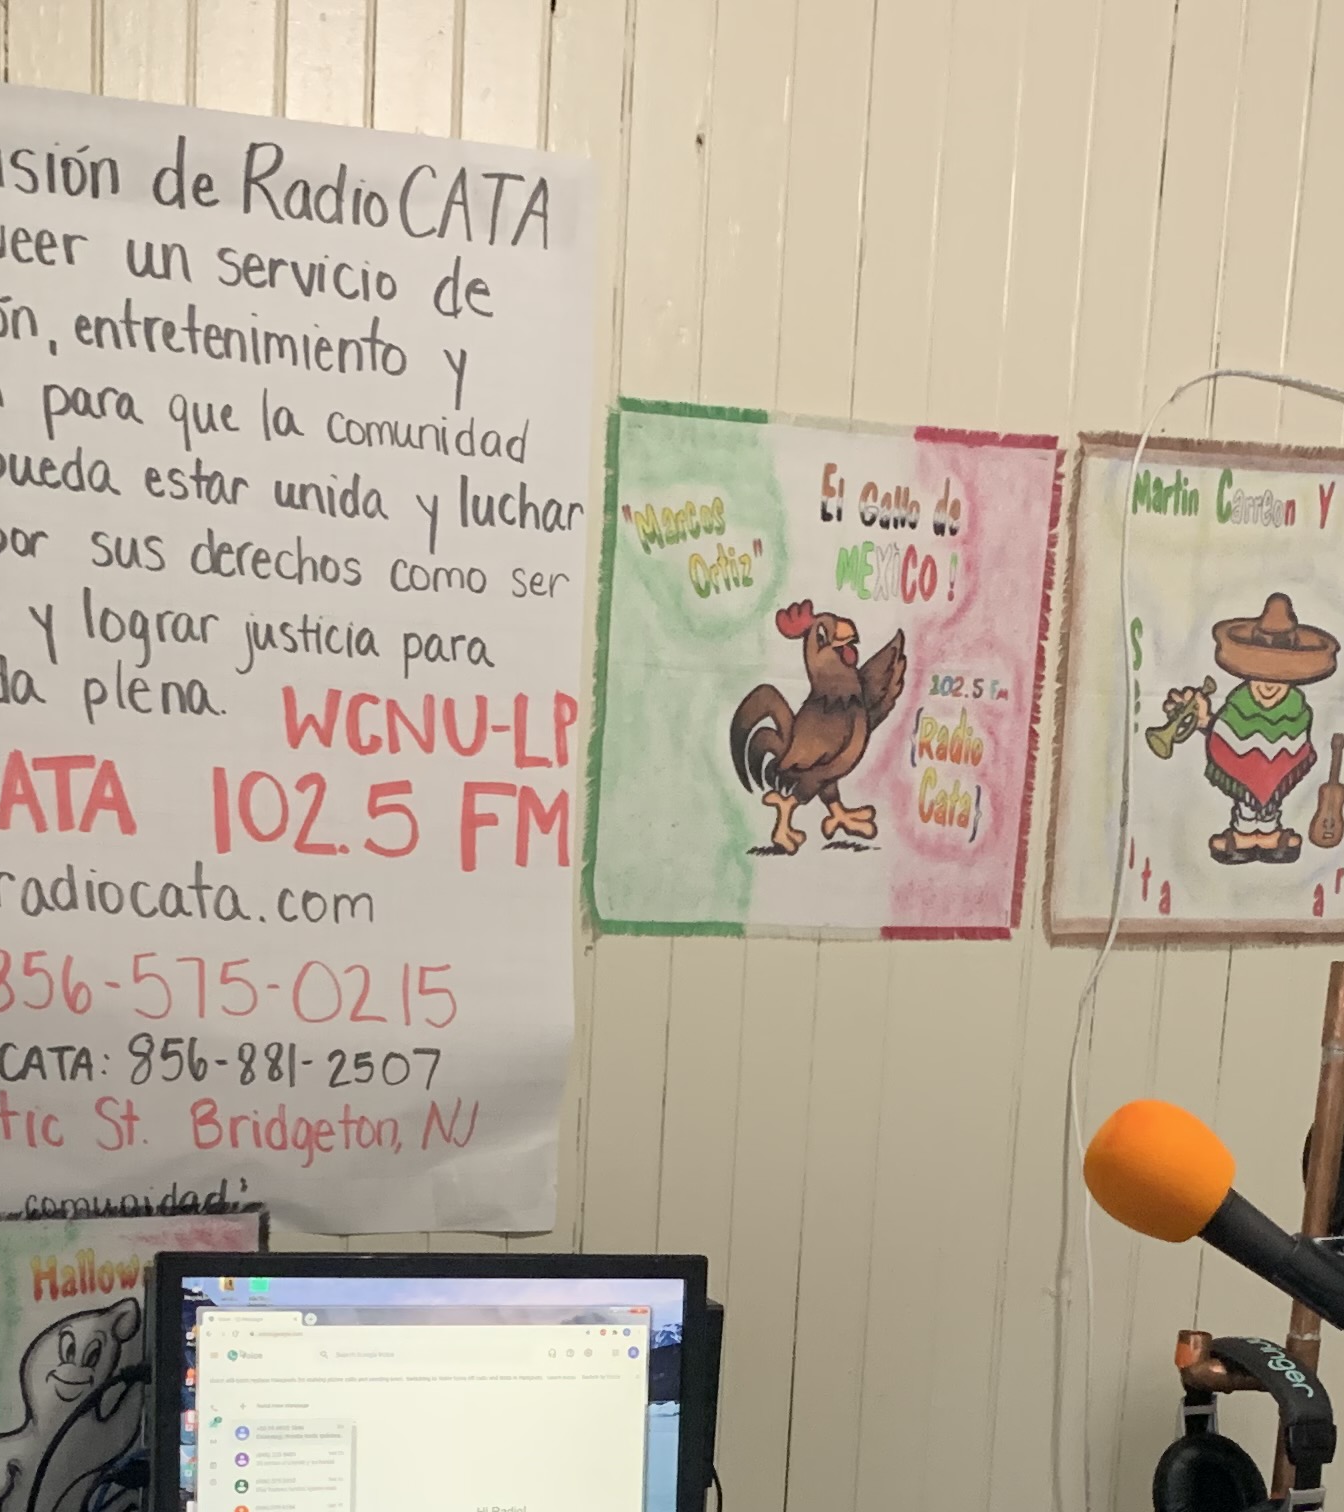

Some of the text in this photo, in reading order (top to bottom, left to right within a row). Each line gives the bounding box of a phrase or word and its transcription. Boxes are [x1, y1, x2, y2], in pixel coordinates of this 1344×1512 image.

[153, 135, 220, 209] de
[127, 239, 192, 282] un
[217, 247, 397, 301] servicio
[434, 256, 493, 319] de
[75, 298, 407, 376] entretenimiento
[443, 349, 467, 410] y
[43, 384, 143, 440] para
[169, 394, 240, 451] que
[263, 388, 304, 441] la
[327, 412, 529, 464] comunidad
[145, 458, 248, 505] estar
[275, 473, 388, 519] unida
[416, 495, 438, 555] y
[460, 475, 584, 533] luchar
[821, 463, 961, 537] El Gallo de
[1132, 469, 1199, 516] Martin
[1216, 468, 1295, 528] Carreon
[1319, 481, 1335, 529] Y
[91, 531, 165, 571] sus
[191, 528, 361, 586] derechos
[390, 559, 486, 593] como
[512, 568, 569, 598] ser
[29, 604, 57, 664] y
[83, 587, 219, 668] lograr
[236, 614, 379, 674] justicia
[404, 633, 495, 680] para
[84, 660, 226, 724] plena.
[929, 675, 984, 699] 102.5
[282, 686, 577, 769] WCNU-LP
[213, 767, 419, 857] 102.5
[461, 782, 569, 872] FM
[128, 1033, 440, 1090] 856-881-2507
[95, 1097, 148, 1150] St.
[191, 1098, 401, 1167] Bridgeton,
[422, 1099, 478, 1149] NJ
